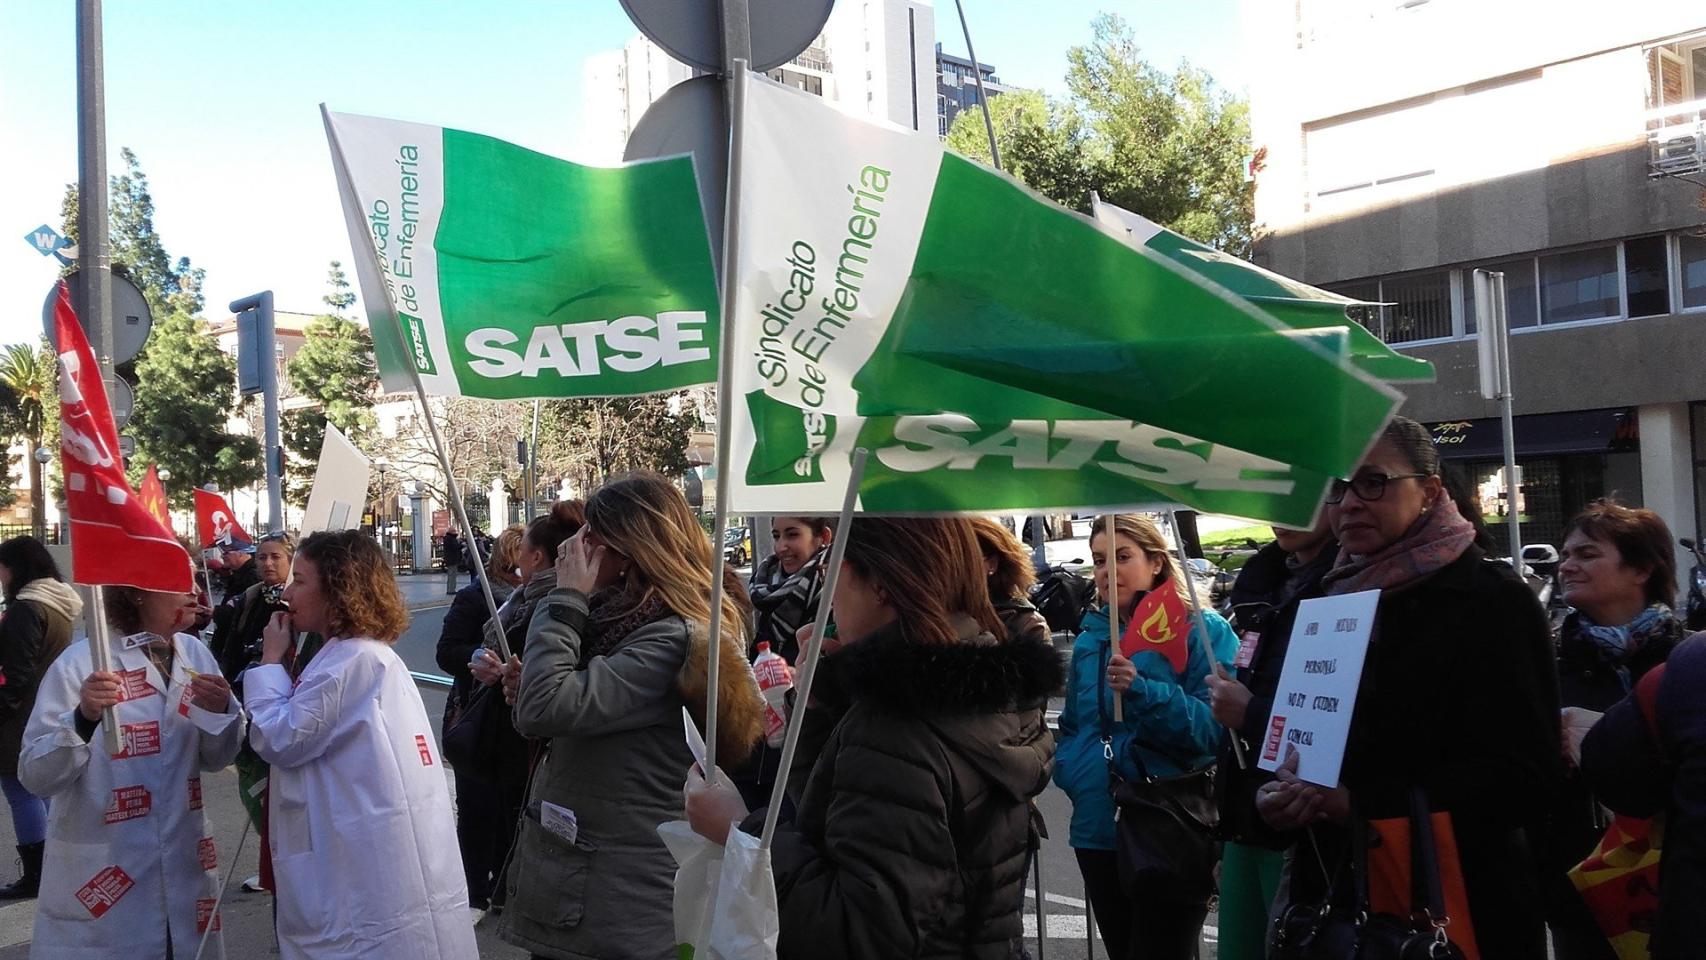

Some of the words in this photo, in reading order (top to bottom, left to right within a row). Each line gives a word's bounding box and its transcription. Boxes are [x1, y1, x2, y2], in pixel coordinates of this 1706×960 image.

[34, 232, 57, 248] W
[394, 145, 420, 278] Enfermería
[791, 164, 891, 364] Enfermería
[400, 285, 417, 312] de
[754, 240, 817, 387] Sindicato
[464, 311, 711, 378] SATSE
[798, 363, 827, 408] de
